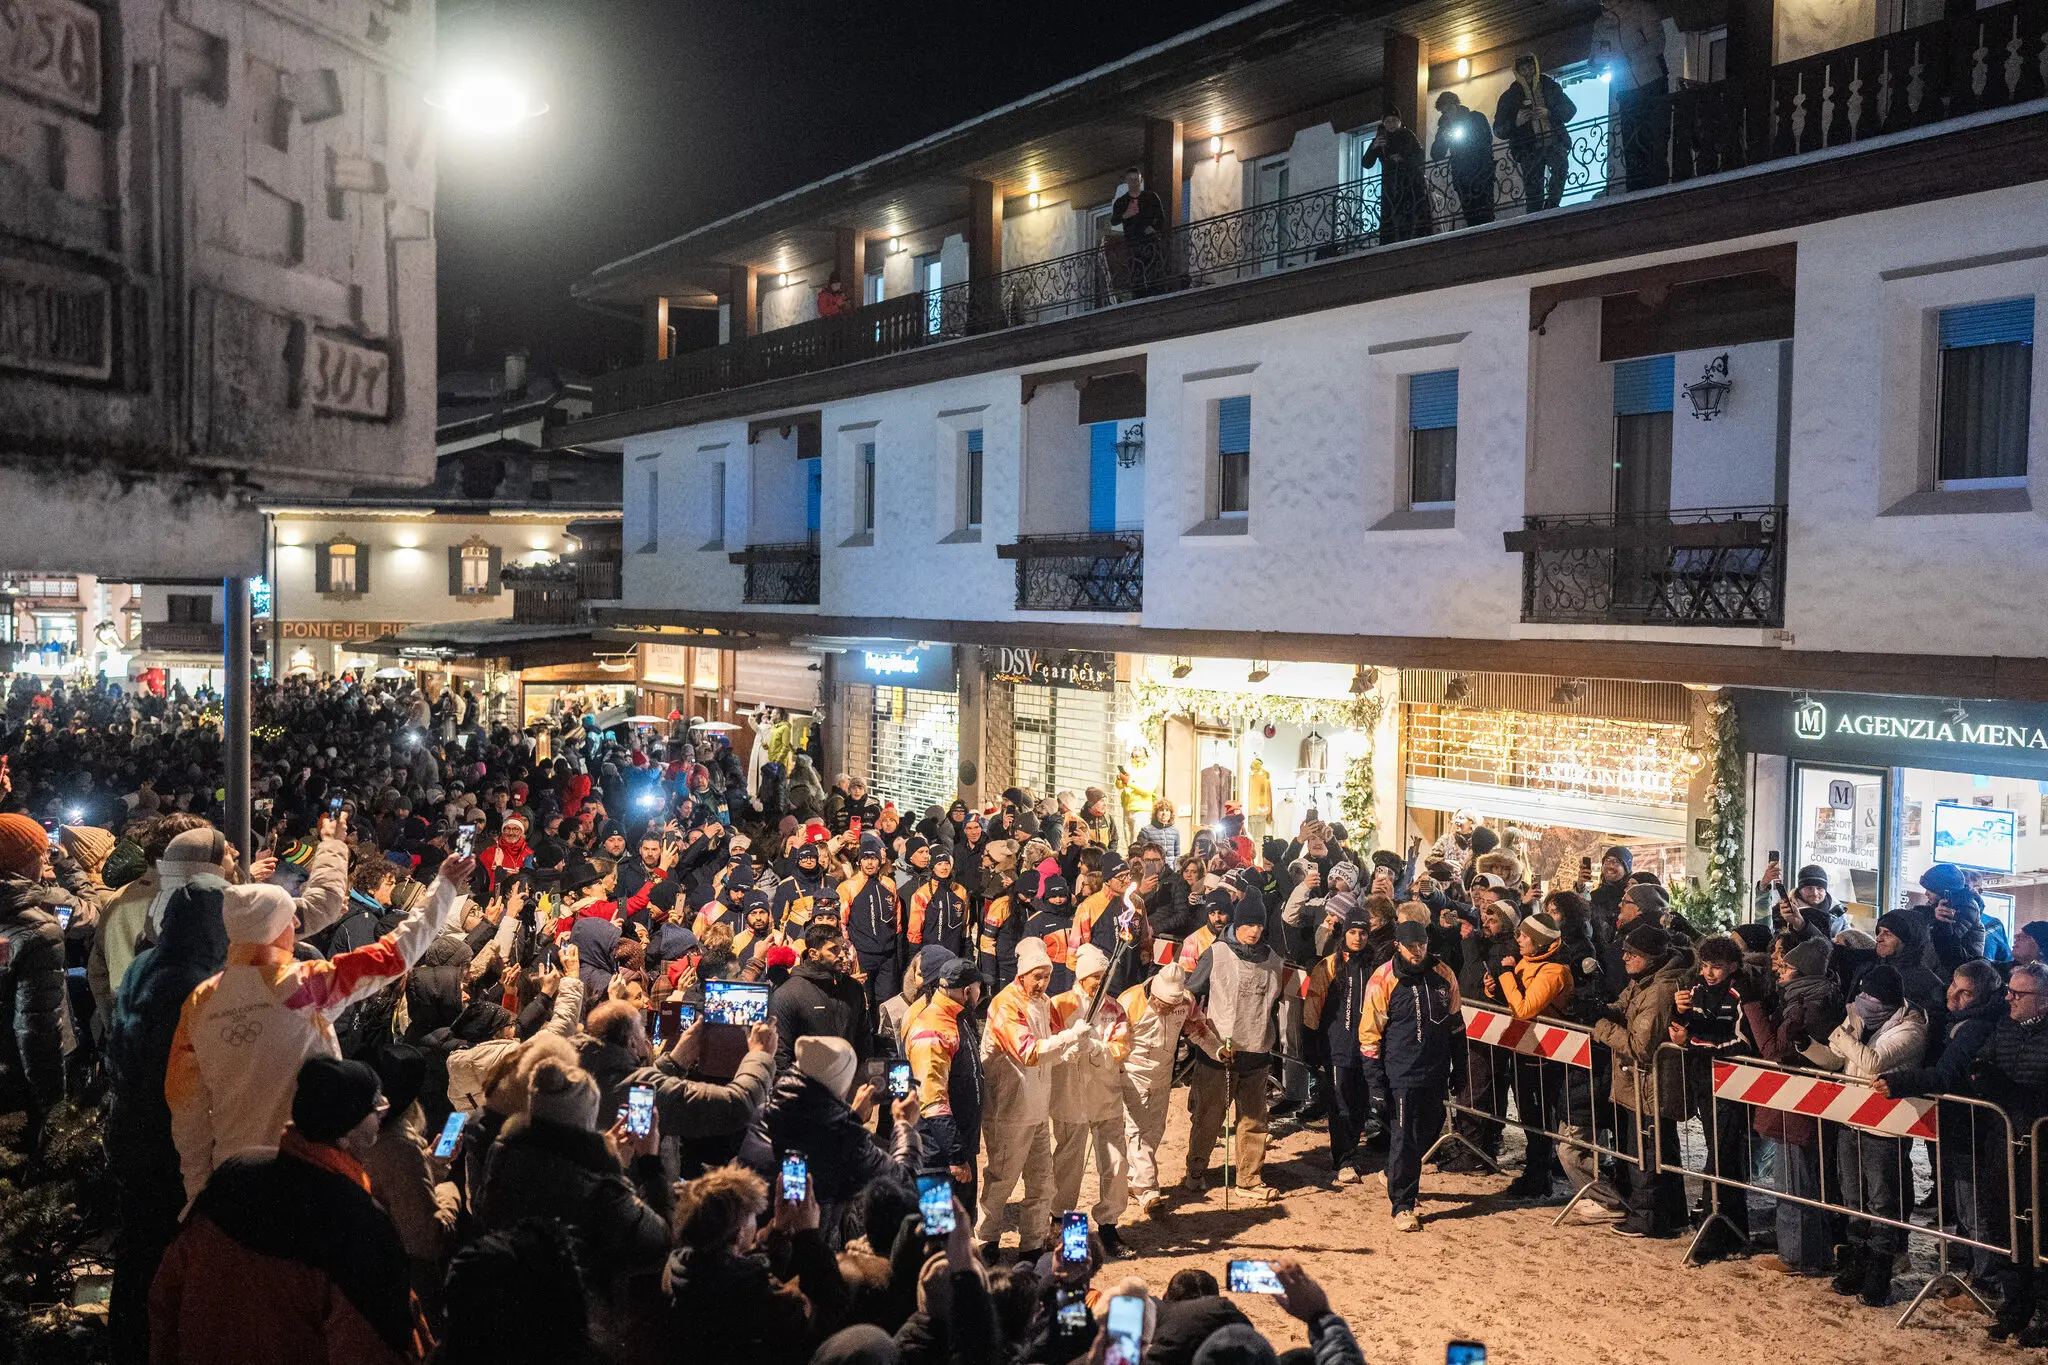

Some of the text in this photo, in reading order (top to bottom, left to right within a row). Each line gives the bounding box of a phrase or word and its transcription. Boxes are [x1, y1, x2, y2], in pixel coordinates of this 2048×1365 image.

[282, 622, 375, 639] PONTEJEL
[999, 647, 1104, 684] DSV carpets
[1801, 710, 1820, 733] M
[1835, 713, 2048, 750] AGENZIA MENA
[1834, 785, 1849, 805] M
[1810, 853, 1868, 869] CONDOMINIALI
[1344, 1009, 1352, 1032] MILANO
